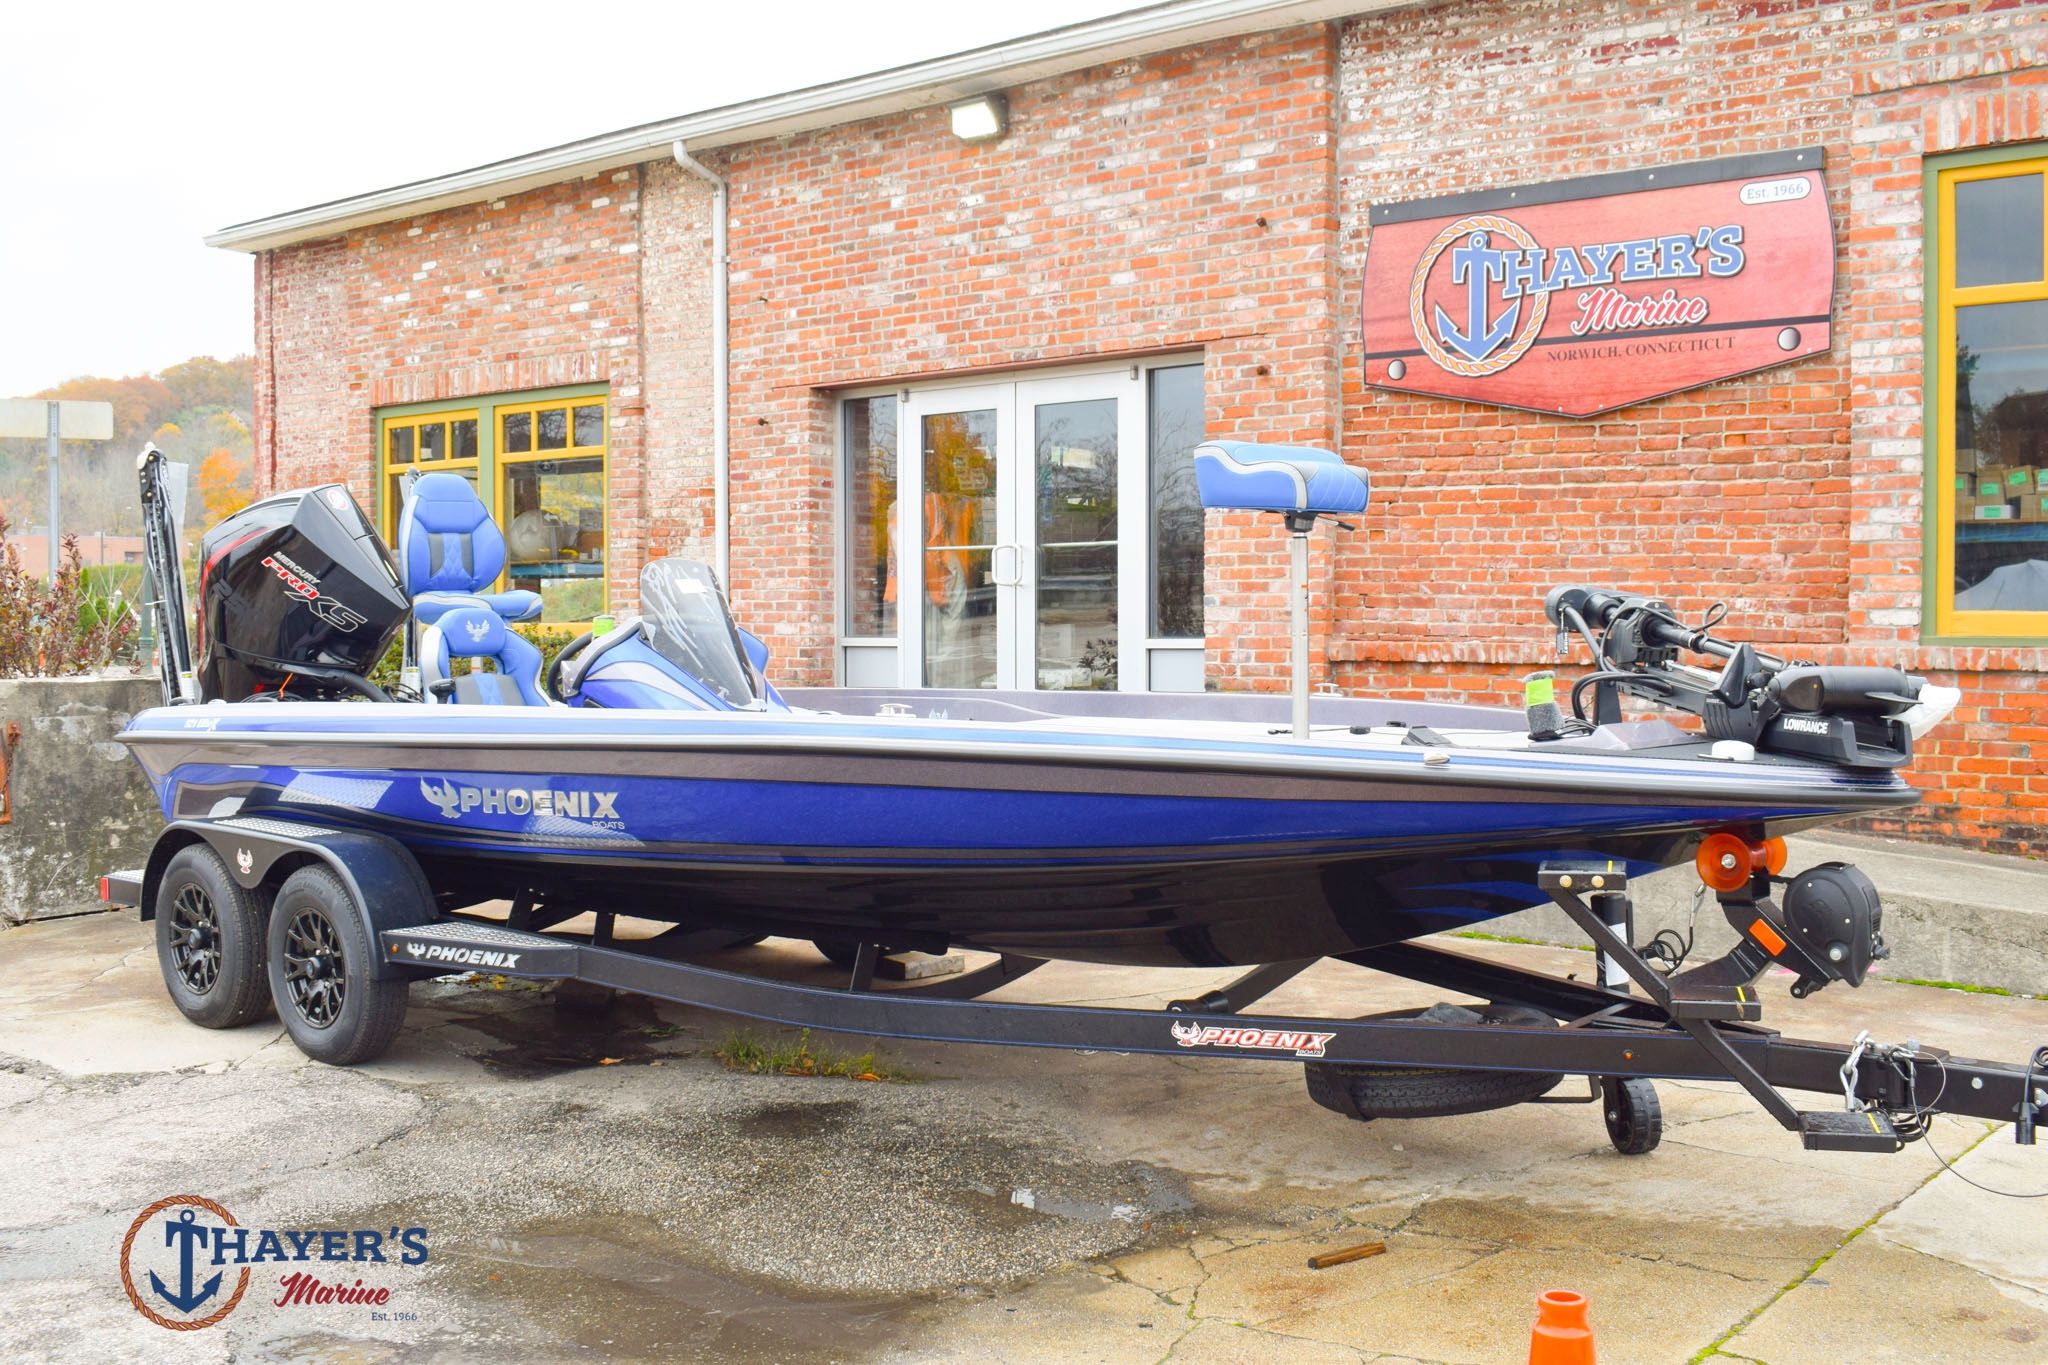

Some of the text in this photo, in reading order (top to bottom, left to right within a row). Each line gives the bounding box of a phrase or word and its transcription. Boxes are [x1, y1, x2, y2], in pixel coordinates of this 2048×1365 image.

[1747, 182, 1804, 200] Est. 1966
[1451, 225, 1746, 332] THAYER'S
[1570, 288, 1710, 335] Marine
[1625, 336, 1736, 357] CONNECTICUT
[261, 556, 320, 600] PRO
[273, 551, 321, 584] MERCURY
[283, 590, 369, 633] XS
[1783, 718, 1829, 735] LOWRANCE
[460, 788, 620, 819] PHOENIX
[592, 821, 625, 830] BOATS
[425, 945, 521, 969] PHOENIX
[1201, 1028, 1333, 1050] PHOENIX
